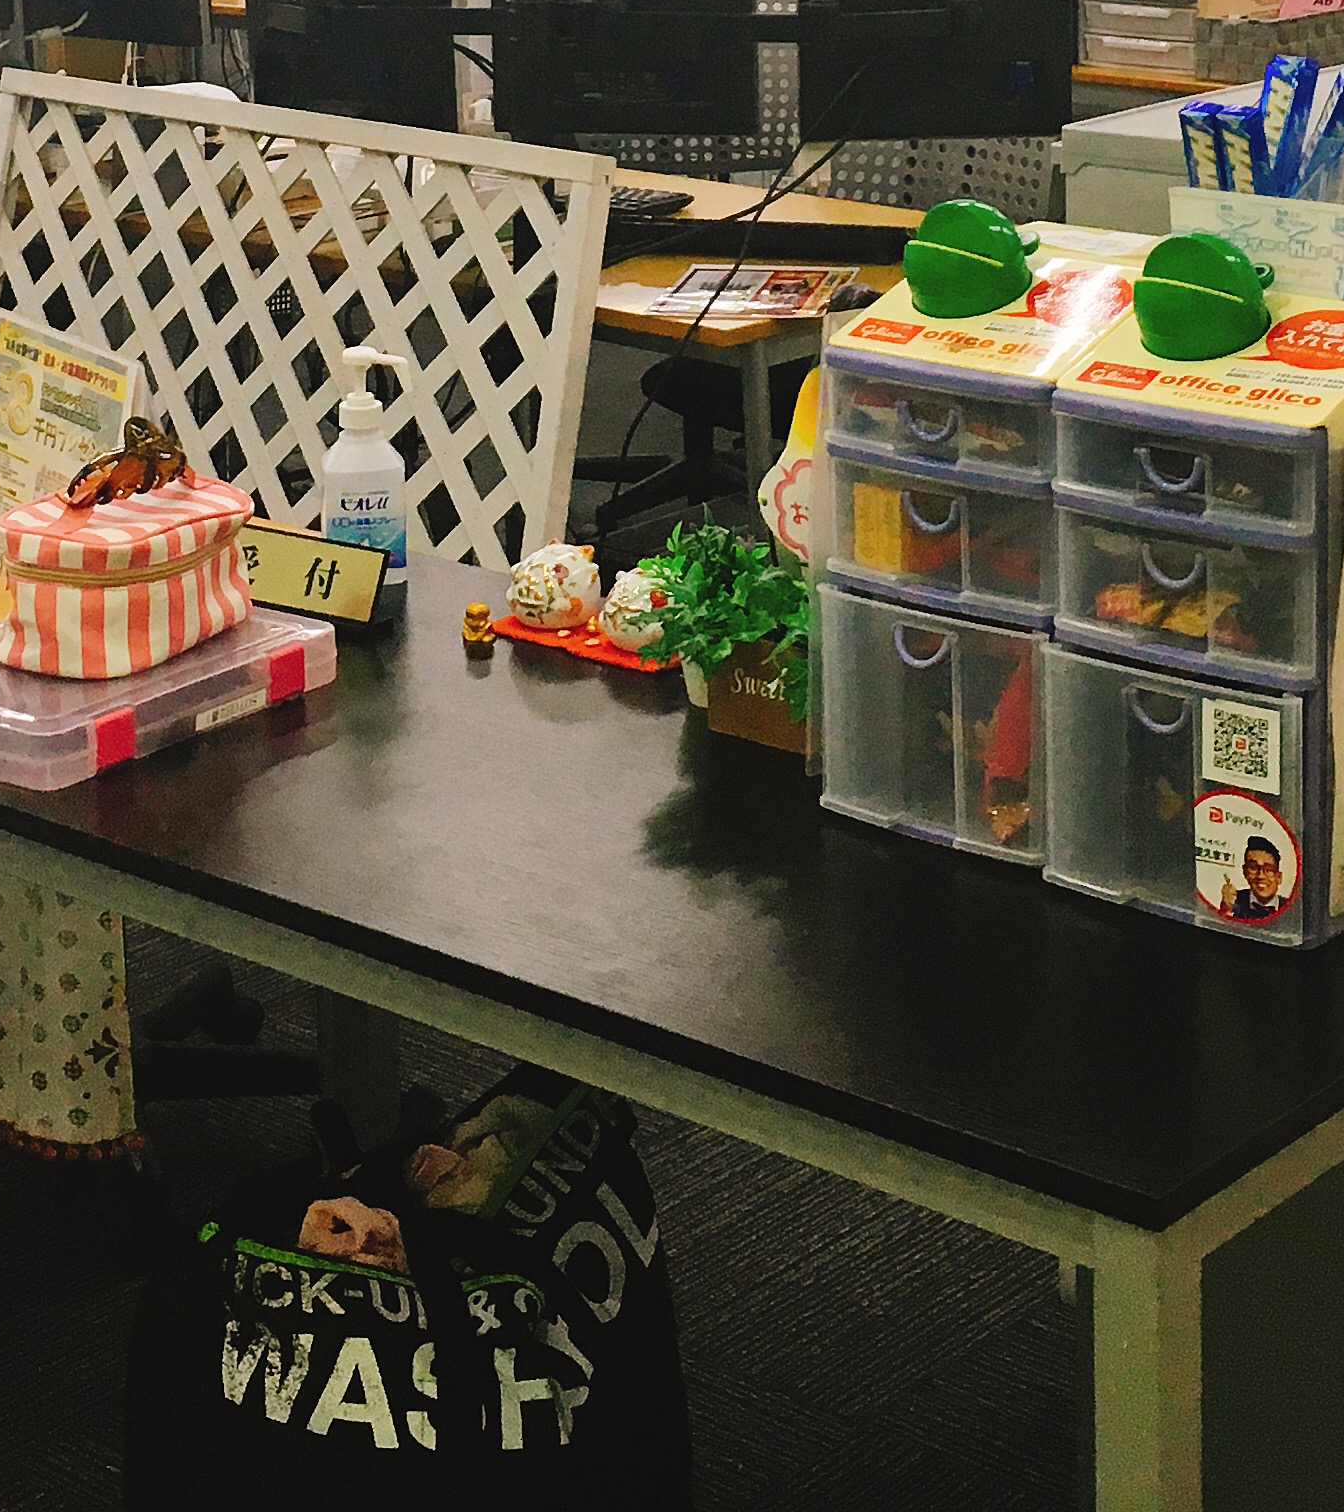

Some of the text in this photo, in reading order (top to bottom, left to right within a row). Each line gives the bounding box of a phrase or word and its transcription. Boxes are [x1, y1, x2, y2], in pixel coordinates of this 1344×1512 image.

[861, 324, 906, 339] Glico
[922, 329, 995, 349] office
[1089, 368, 1143, 385] Glico
[1158, 374, 1323, 406] office glico
[1225, 811, 1265, 830] PayPay
[222, 1254, 428, 1330] ICK-U
